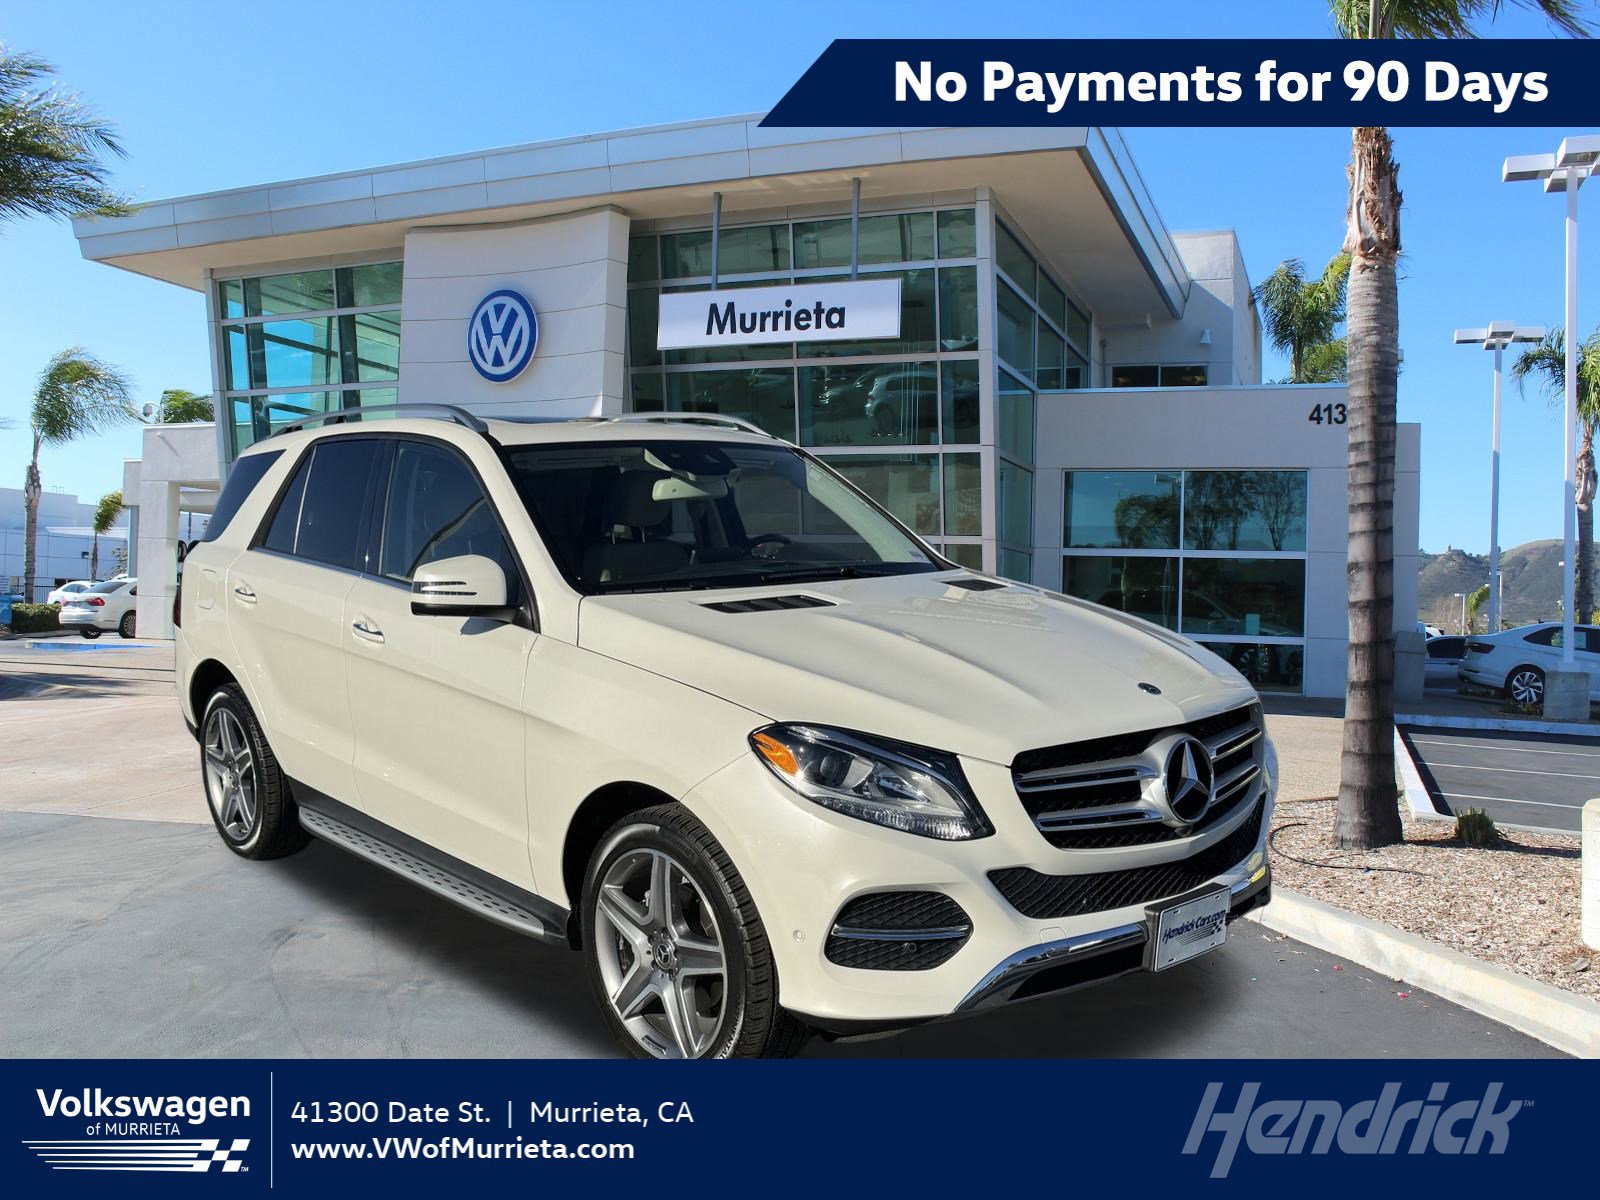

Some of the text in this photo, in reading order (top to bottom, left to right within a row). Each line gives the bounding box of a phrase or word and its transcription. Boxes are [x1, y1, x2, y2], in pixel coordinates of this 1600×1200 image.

[705, 298, 847, 336] Murrieta
[470, 295, 531, 376] VW
[1308, 403, 1347, 425] 413
[1162, 918, 1196, 944] Hendrick
